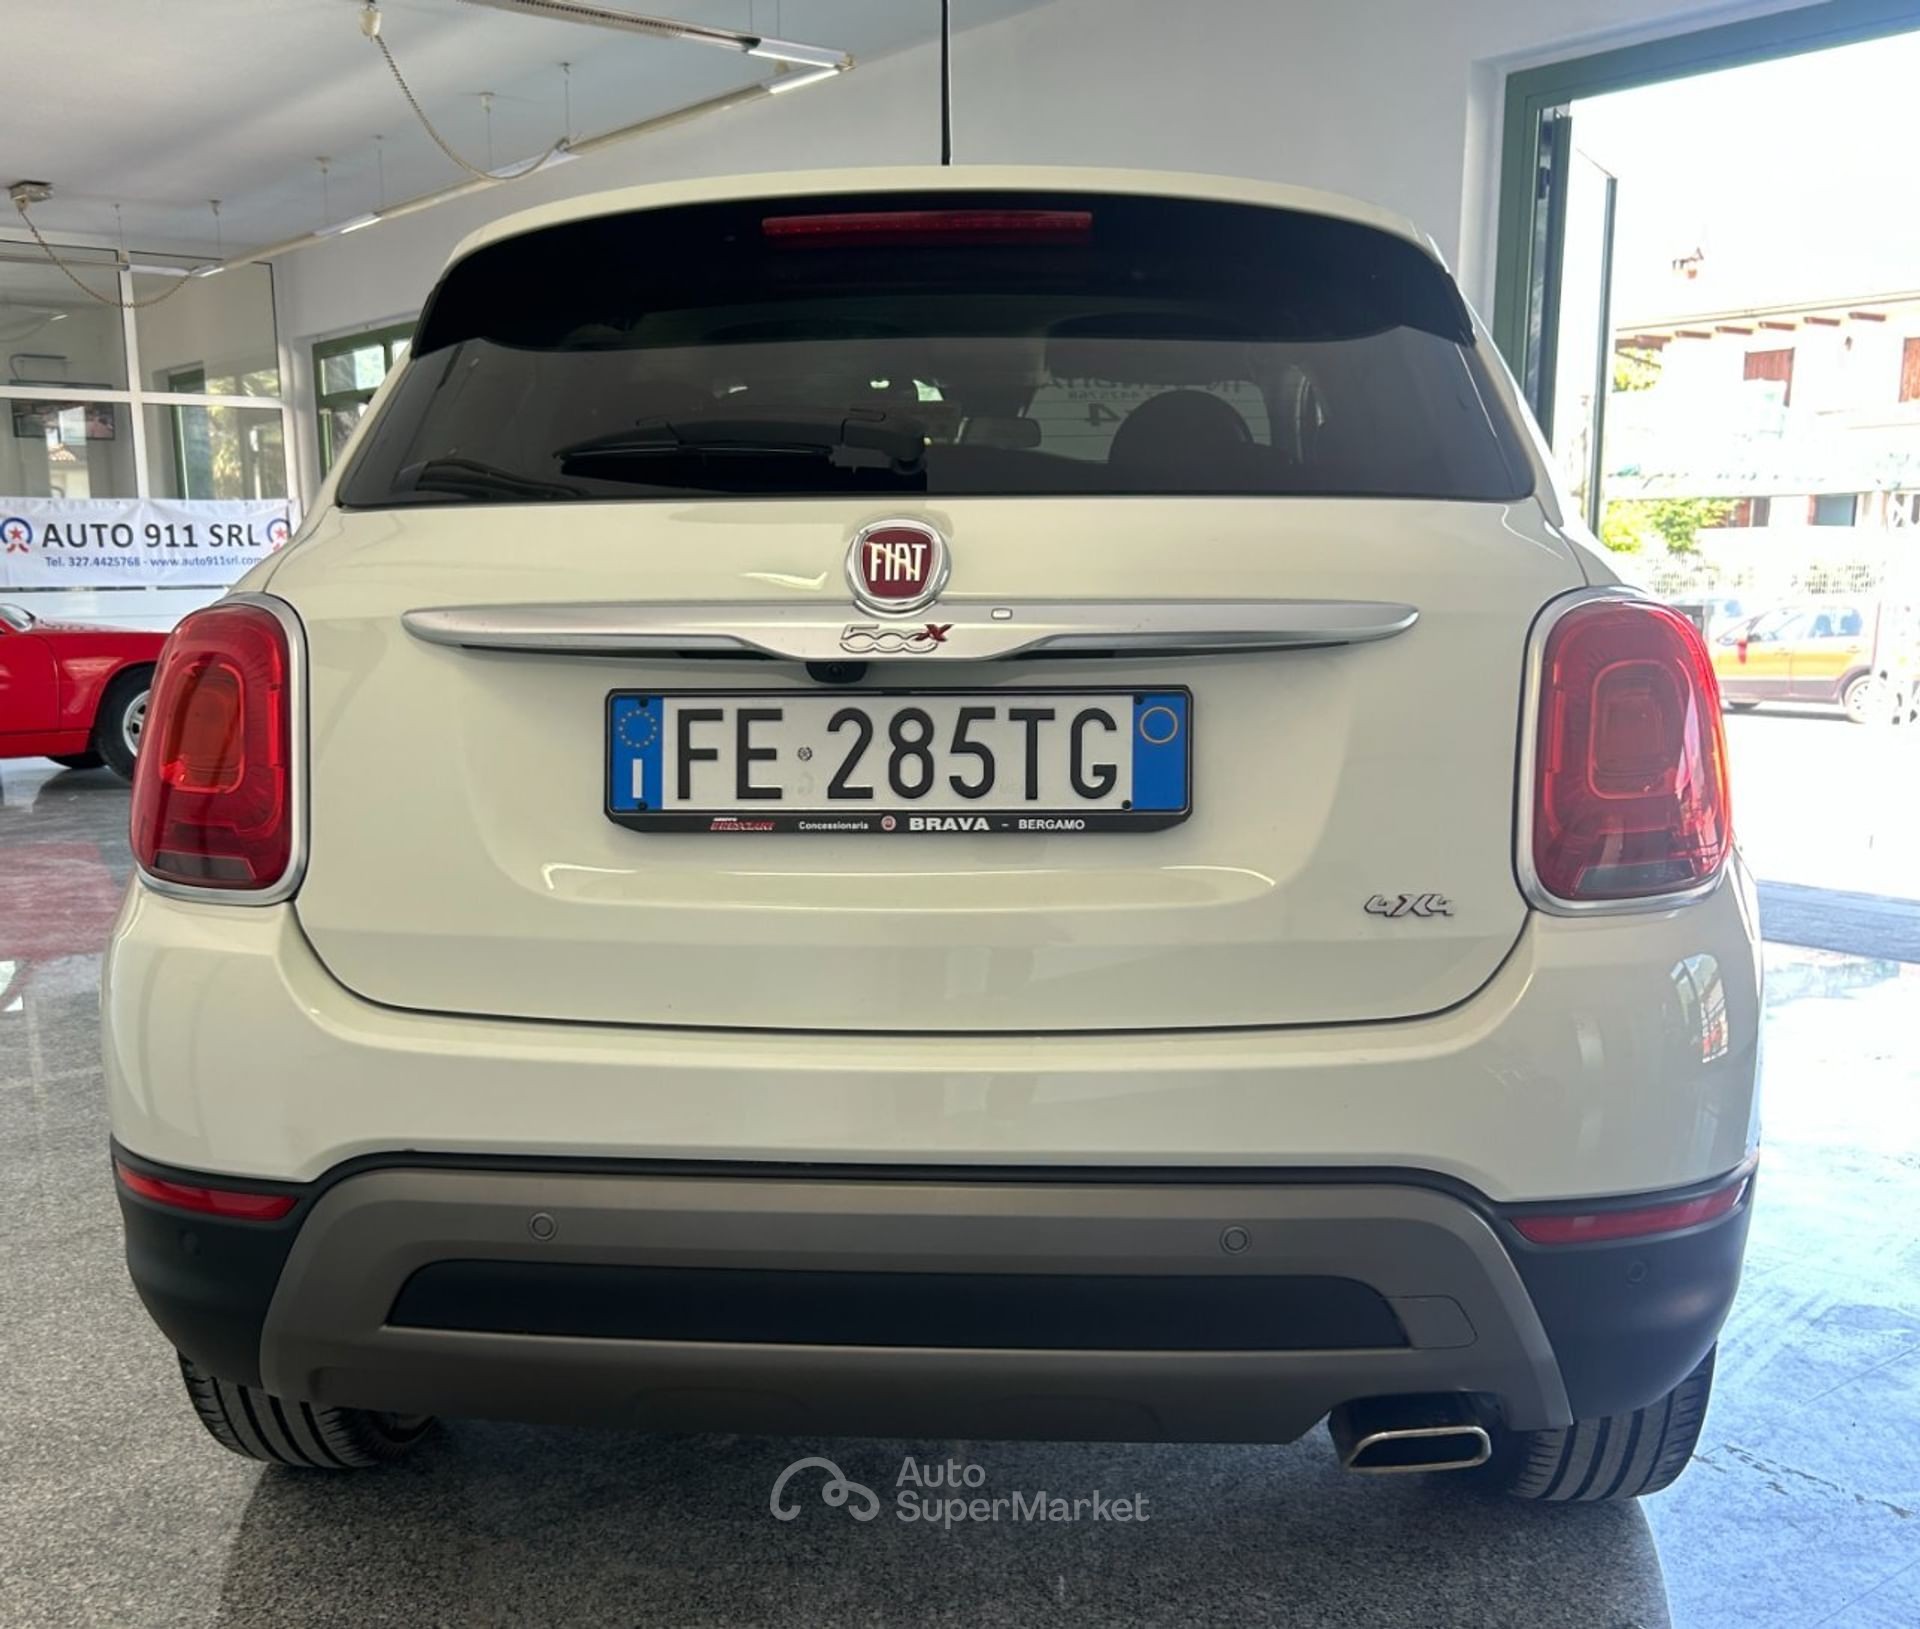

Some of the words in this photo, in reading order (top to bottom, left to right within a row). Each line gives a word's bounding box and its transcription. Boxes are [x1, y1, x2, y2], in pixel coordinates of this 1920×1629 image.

[42, 523, 134, 548] AUTO
[144, 523, 198, 548] 911
[209, 523, 261, 547] SRL
[44, 557, 65, 568] Tel.
[866, 543, 928, 582] FIAT
[798, 820, 869, 831] Concessionaria
[909, 817, 990, 832] BRAVA
[1018, 818, 1086, 831] BERGAMO
